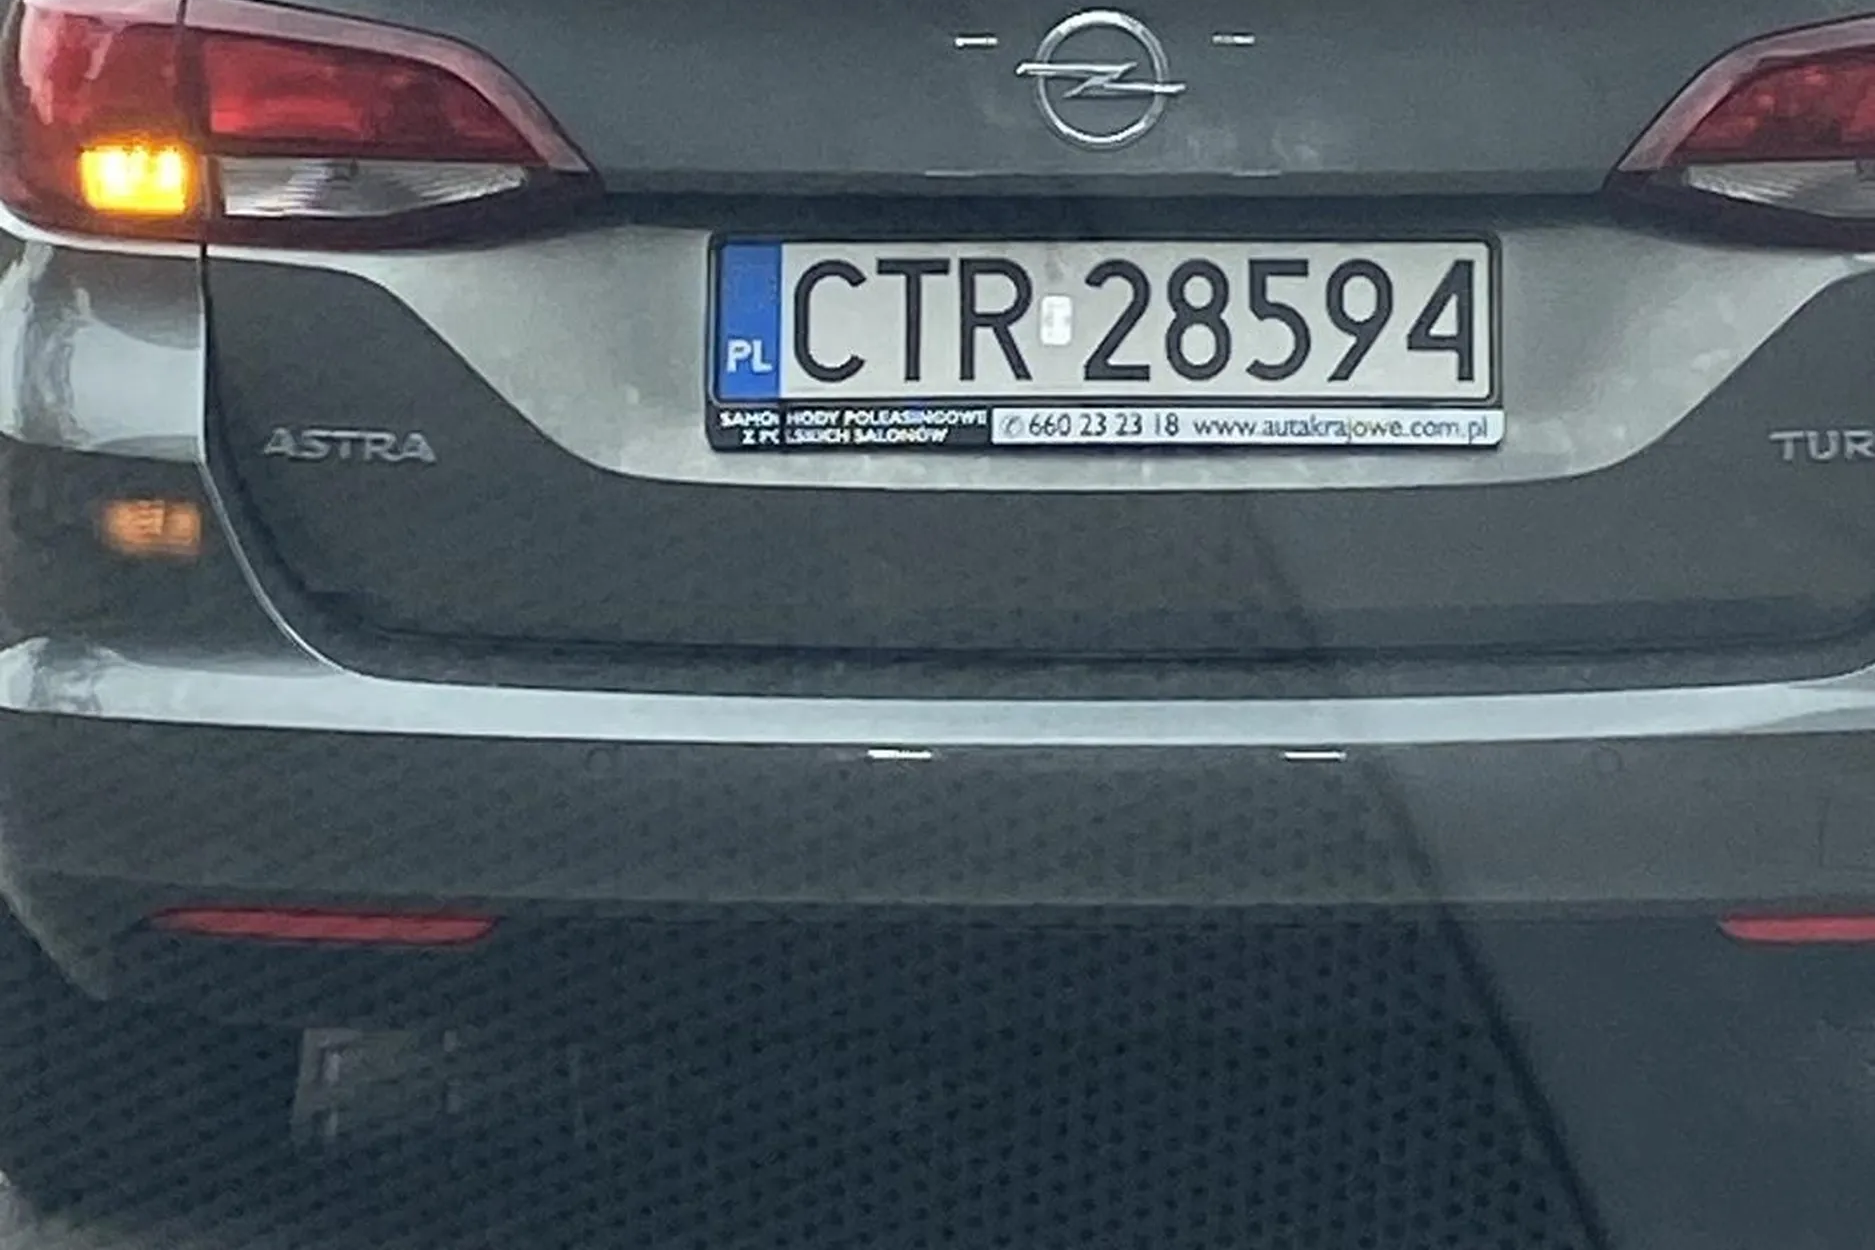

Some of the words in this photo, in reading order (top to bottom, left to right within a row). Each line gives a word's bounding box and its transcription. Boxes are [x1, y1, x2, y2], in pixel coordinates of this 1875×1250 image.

[793, 258, 1034, 384] CTR
[1083, 257, 1476, 383] 28594
[727, 338, 774, 374] PL
[262, 426, 438, 464] ASTRA
[1028, 413, 1072, 437] 660
[1079, 413, 1108, 437] 23
[1115, 413, 1143, 437] 23
[1154, 412, 1180, 437] 18
[1192, 415, 1488, 445] www.autakrajowe.com.pl
